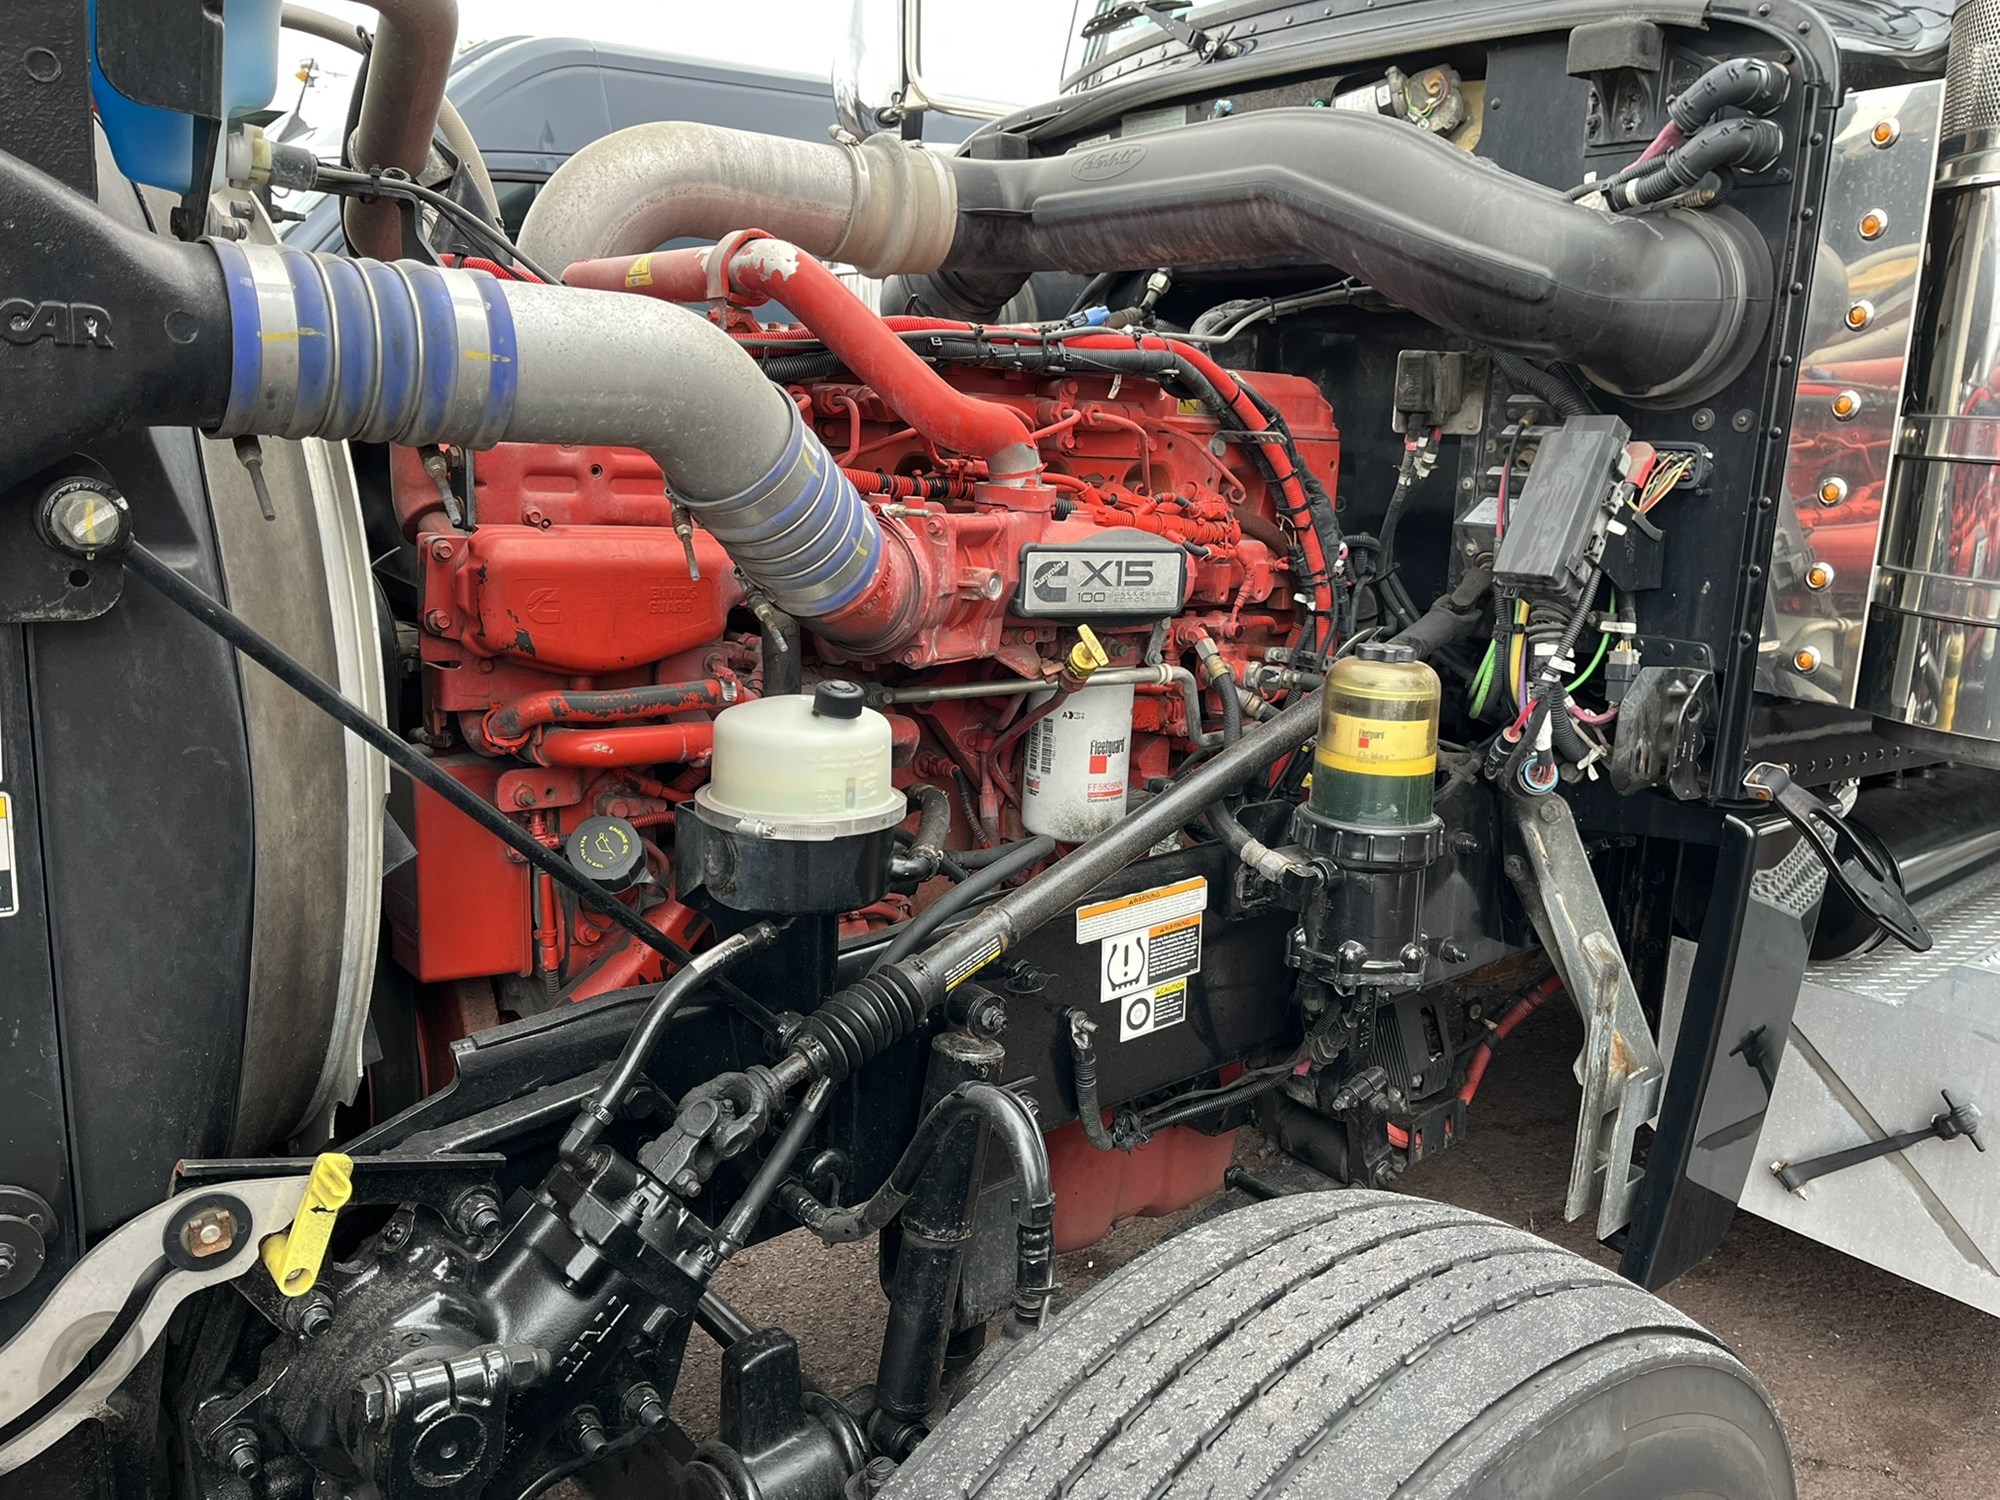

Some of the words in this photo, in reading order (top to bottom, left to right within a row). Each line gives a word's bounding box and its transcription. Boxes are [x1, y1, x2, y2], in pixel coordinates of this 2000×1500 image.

[1033, 560, 1067, 588] Cummins
[1079, 560, 1154, 588] X15
[1077, 591, 1106, 603] 100
[1089, 738, 1124, 758] Fleetguard
[1133, 891, 1161, 905] WARNING
[1164, 918, 1191, 931] WARNING
[1159, 982, 1185, 995] CAUTION
